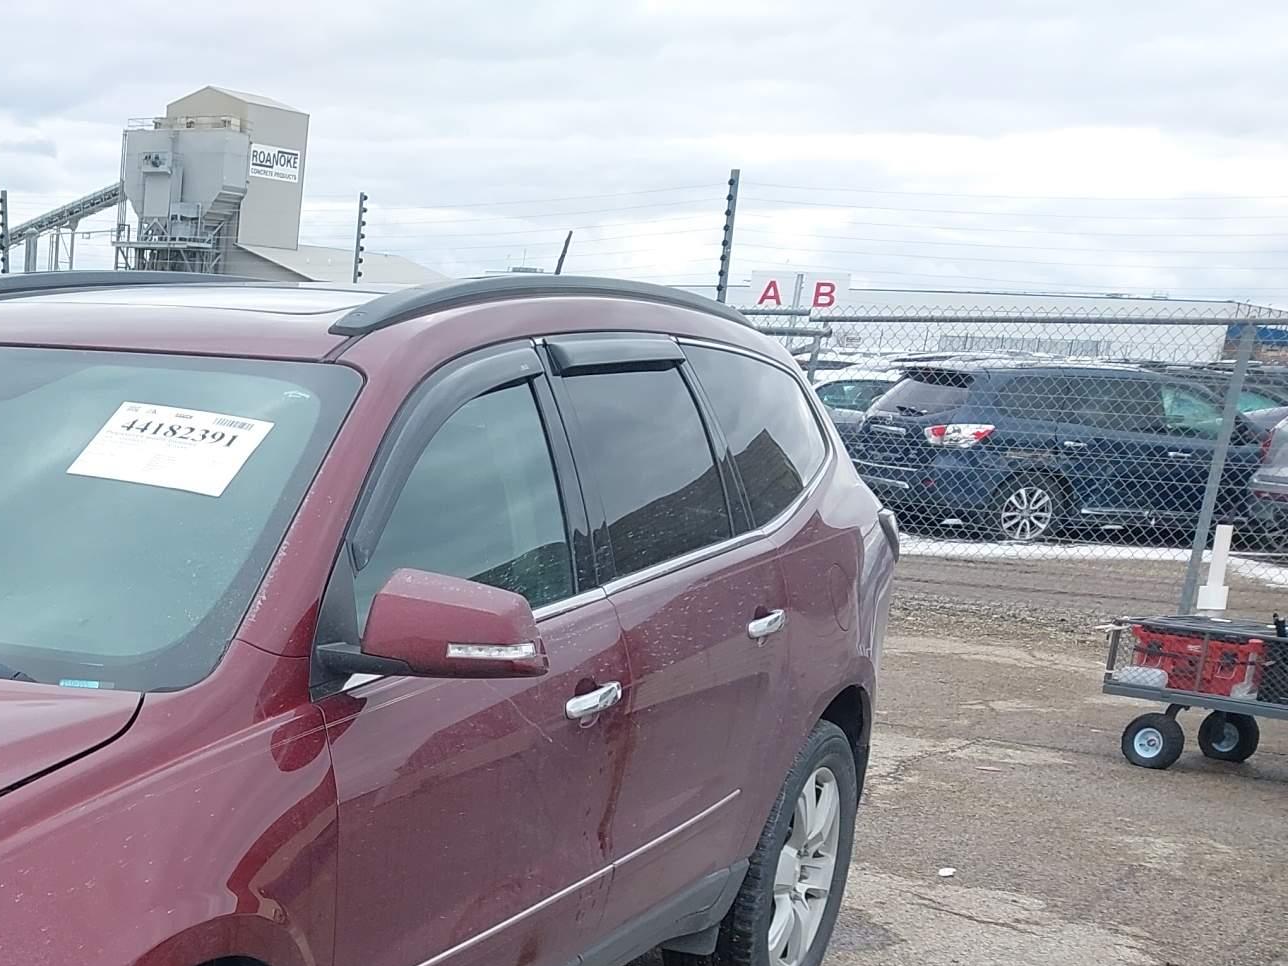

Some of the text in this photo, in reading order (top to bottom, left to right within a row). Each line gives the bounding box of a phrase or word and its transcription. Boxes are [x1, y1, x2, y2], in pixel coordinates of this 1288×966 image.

[252, 150, 299, 169] ROANOKE
[251, 168, 297, 180] CONCRETE PRODUCTS
[758, 280, 782, 306] A
[813, 282, 837, 308] B
[121, 418, 239, 448] 44182391
